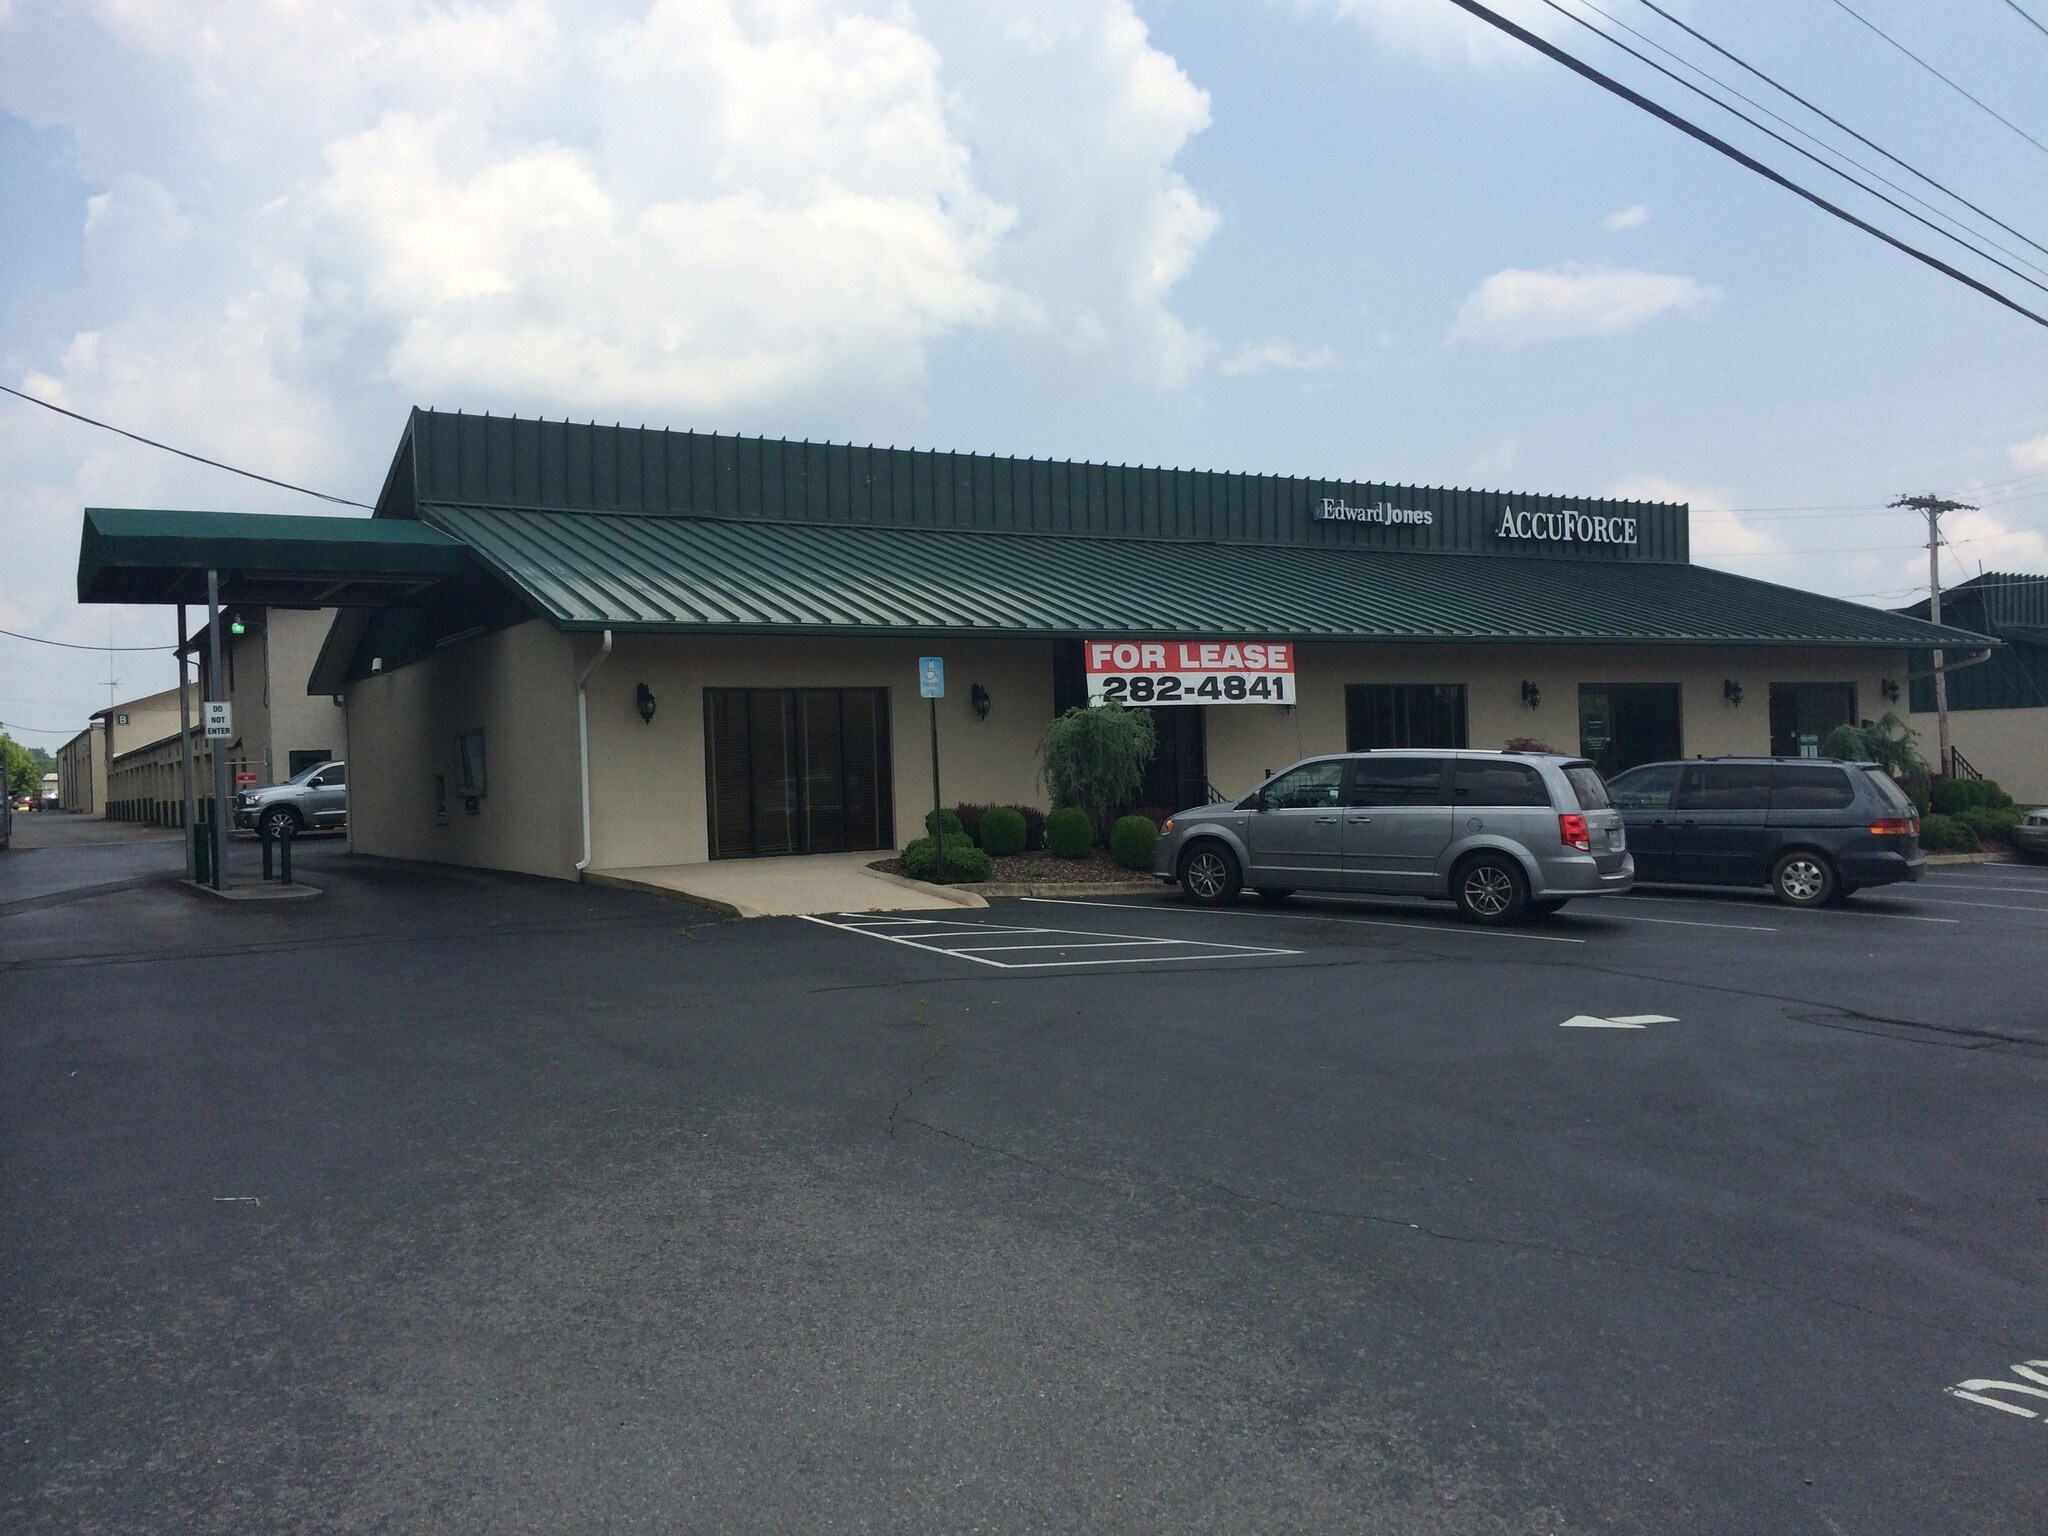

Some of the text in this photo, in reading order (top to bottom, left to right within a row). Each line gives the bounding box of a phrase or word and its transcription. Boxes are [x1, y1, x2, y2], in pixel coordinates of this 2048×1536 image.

[1498, 505, 1638, 545] ACCUFORCE
[1091, 643, 1289, 670] FOR LEASE
[1102, 675, 1284, 703] 282-4841
[212, 705, 223, 713] DO
[119, 715, 127, 724] B
[211, 716, 226, 724] NOT
[207, 727, 231, 735] ENTER
